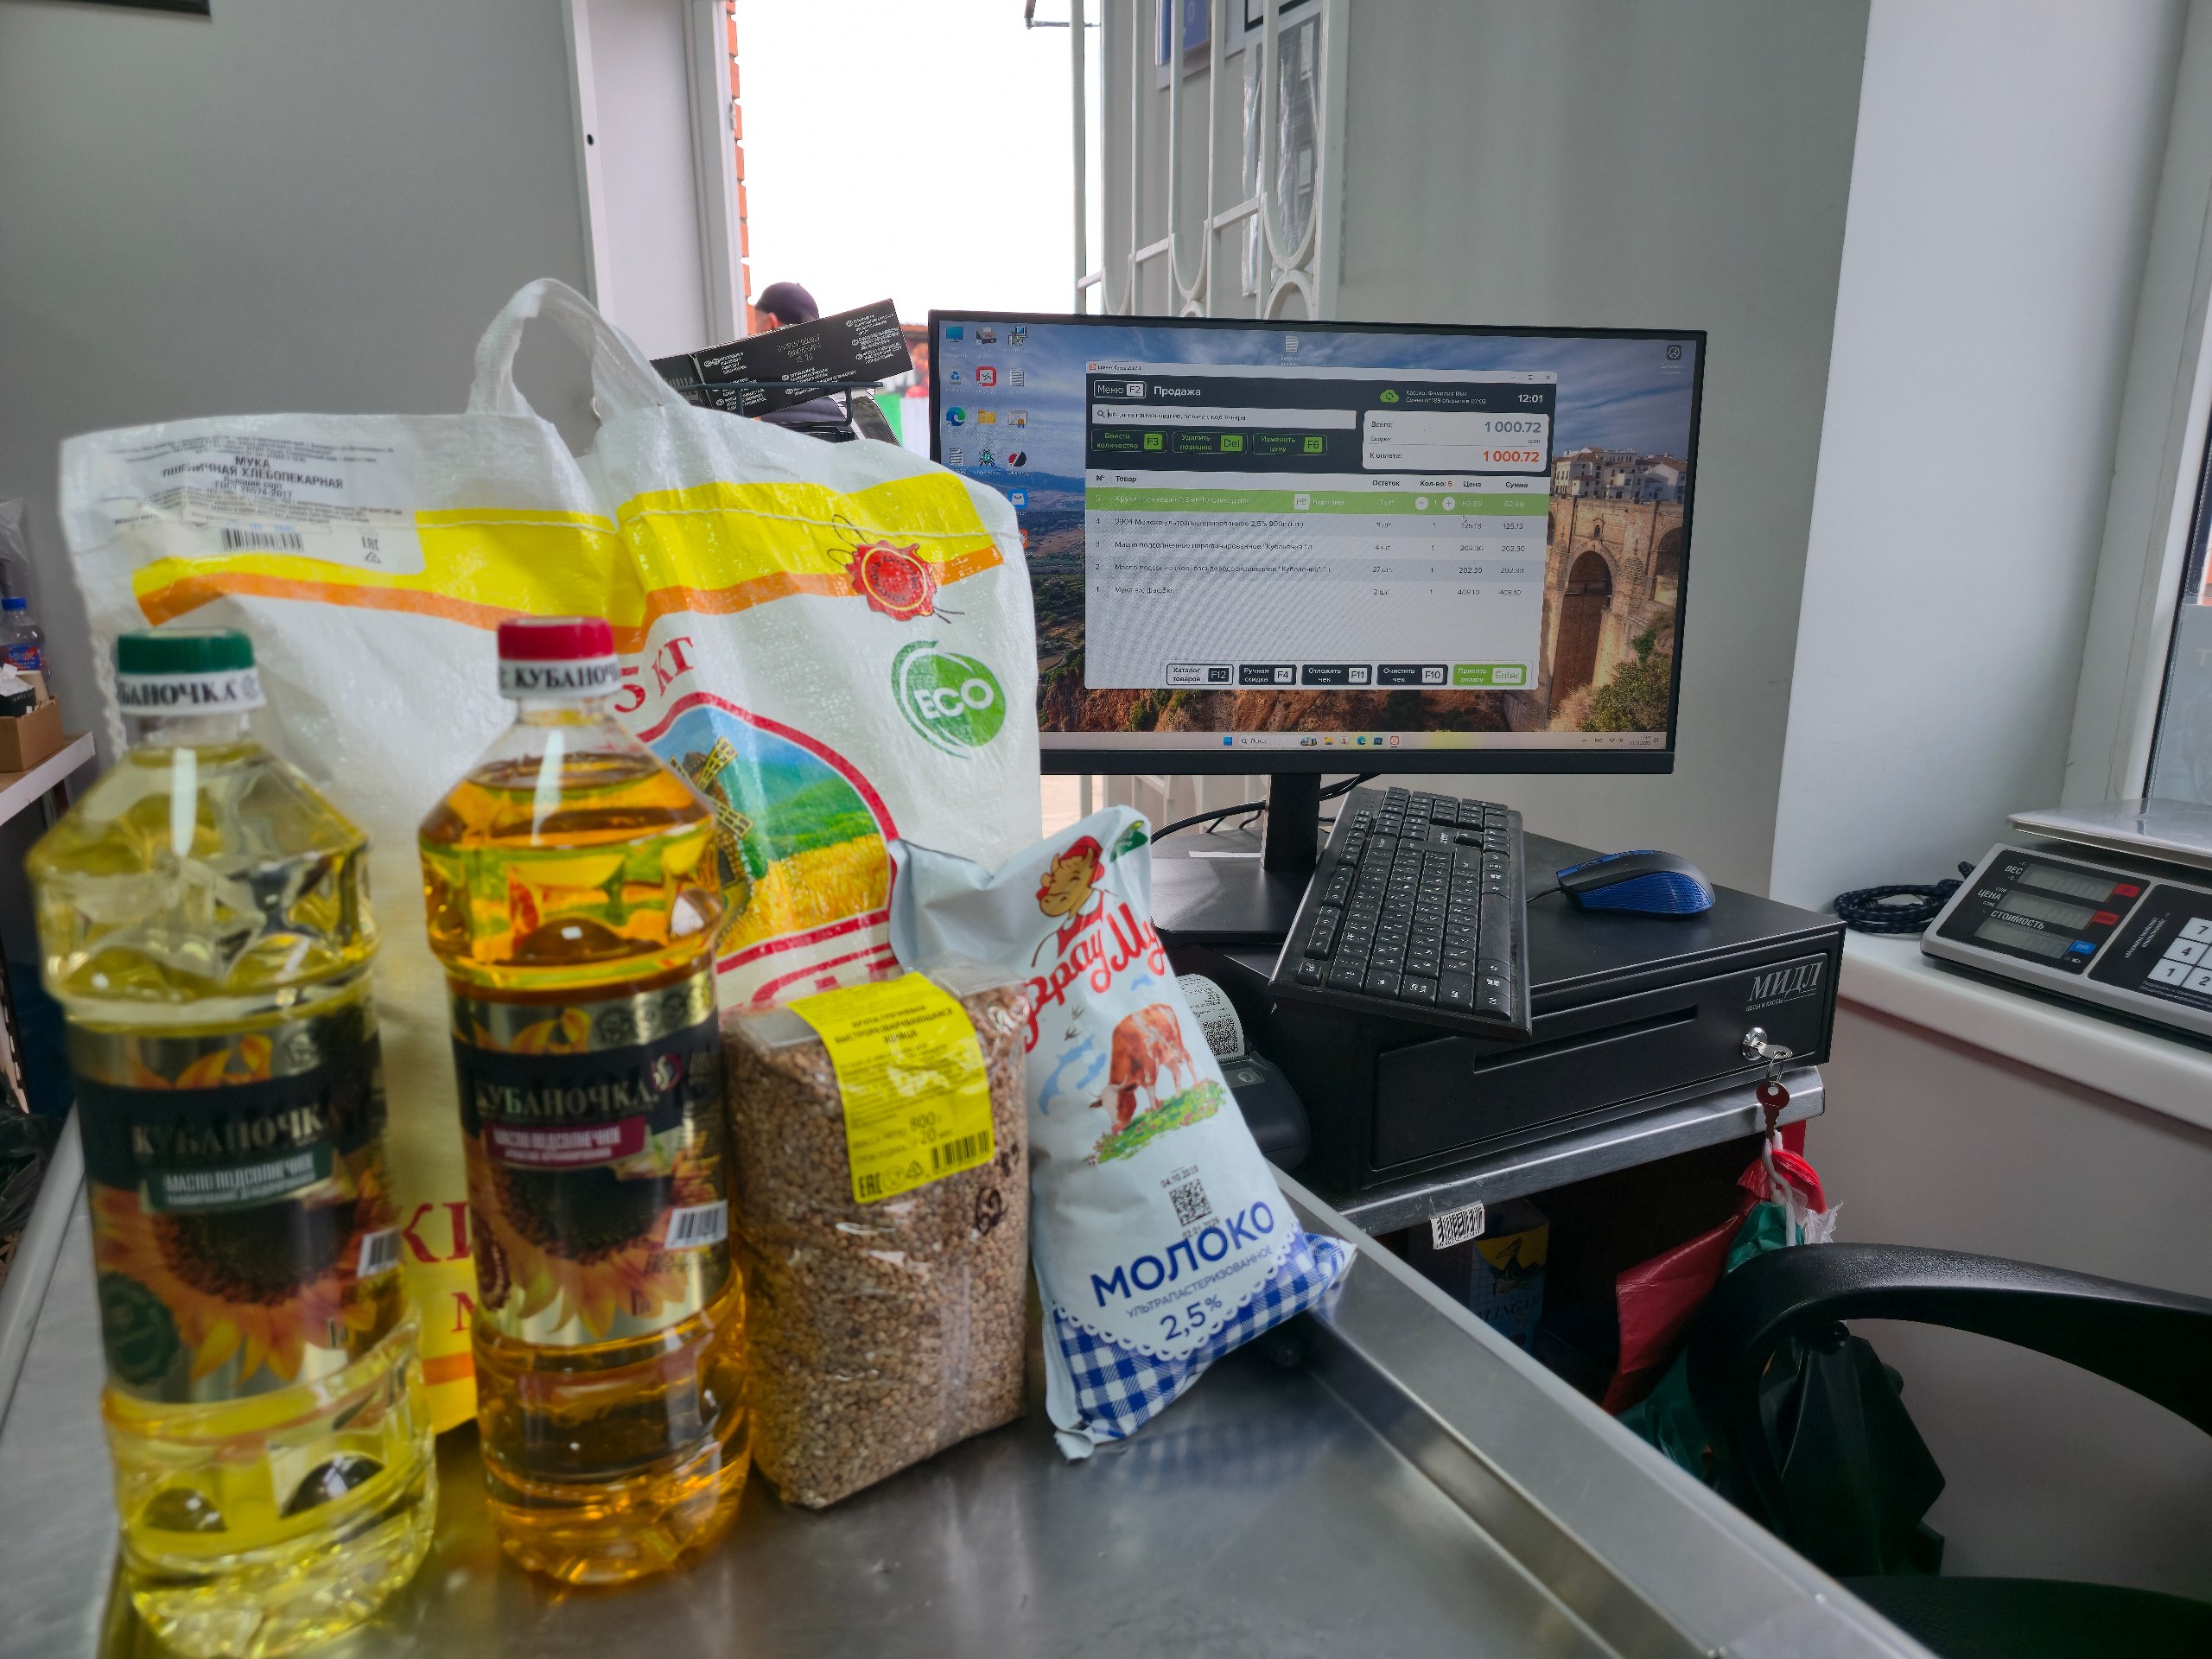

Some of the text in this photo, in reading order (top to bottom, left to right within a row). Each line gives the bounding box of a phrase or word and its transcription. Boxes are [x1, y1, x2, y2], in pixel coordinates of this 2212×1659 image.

[1097, 385, 1123, 394] Меню
[1129, 385, 1141, 394] F2
[1154, 386, 1201, 397] Продажа
[1517, 393, 1543, 404] 12:01
[1147, 437, 1159, 446] F3
[1224, 438, 1240, 448] Del
[1307, 440, 1319, 449] F6
[235, 455, 270, 469] МУКА
[162, 462, 344, 489] ПШЕНИЧНАЯ ХЛЕБОПЕКАРНАЯ
[514, 662, 621, 689] КУБАНОЧ
[1211, 671, 1226, 680] F12
[1277, 671, 1289, 680] F4
[1351, 671, 1364, 679] F11
[1425, 671, 1441, 680] F10
[1495, 671, 1520, 680] Enter
[614, 665, 646, 714] 5
[912, 677, 995, 720] ECO
[2004, 865, 2024, 874] ВЕС
[1977, 889, 2002, 900] ЦЕНА
[1990, 910, 2044, 930] СТОИМОСТЬ
[2198, 925, 2209, 935] 7
[2181, 947, 2192, 956] 4
[2166, 968, 2176, 977] 1
[1747, 961, 1824, 1001] МИДЛ
[2198, 976, 2211, 986] 2
[1745, 1003, 1760, 1012] ВЕСЫ
[1765, 998, 1784, 1007] КАССЫ
[920, 1127, 937, 1145] 20
[1090, 1201, 1274, 1307] МОЛОКО
[1125, 1244, 1273, 1319] УЛЬТРАПАСТЕРИЗОВАННОЕ
[1160, 1294, 1223, 1341] 2,5%
